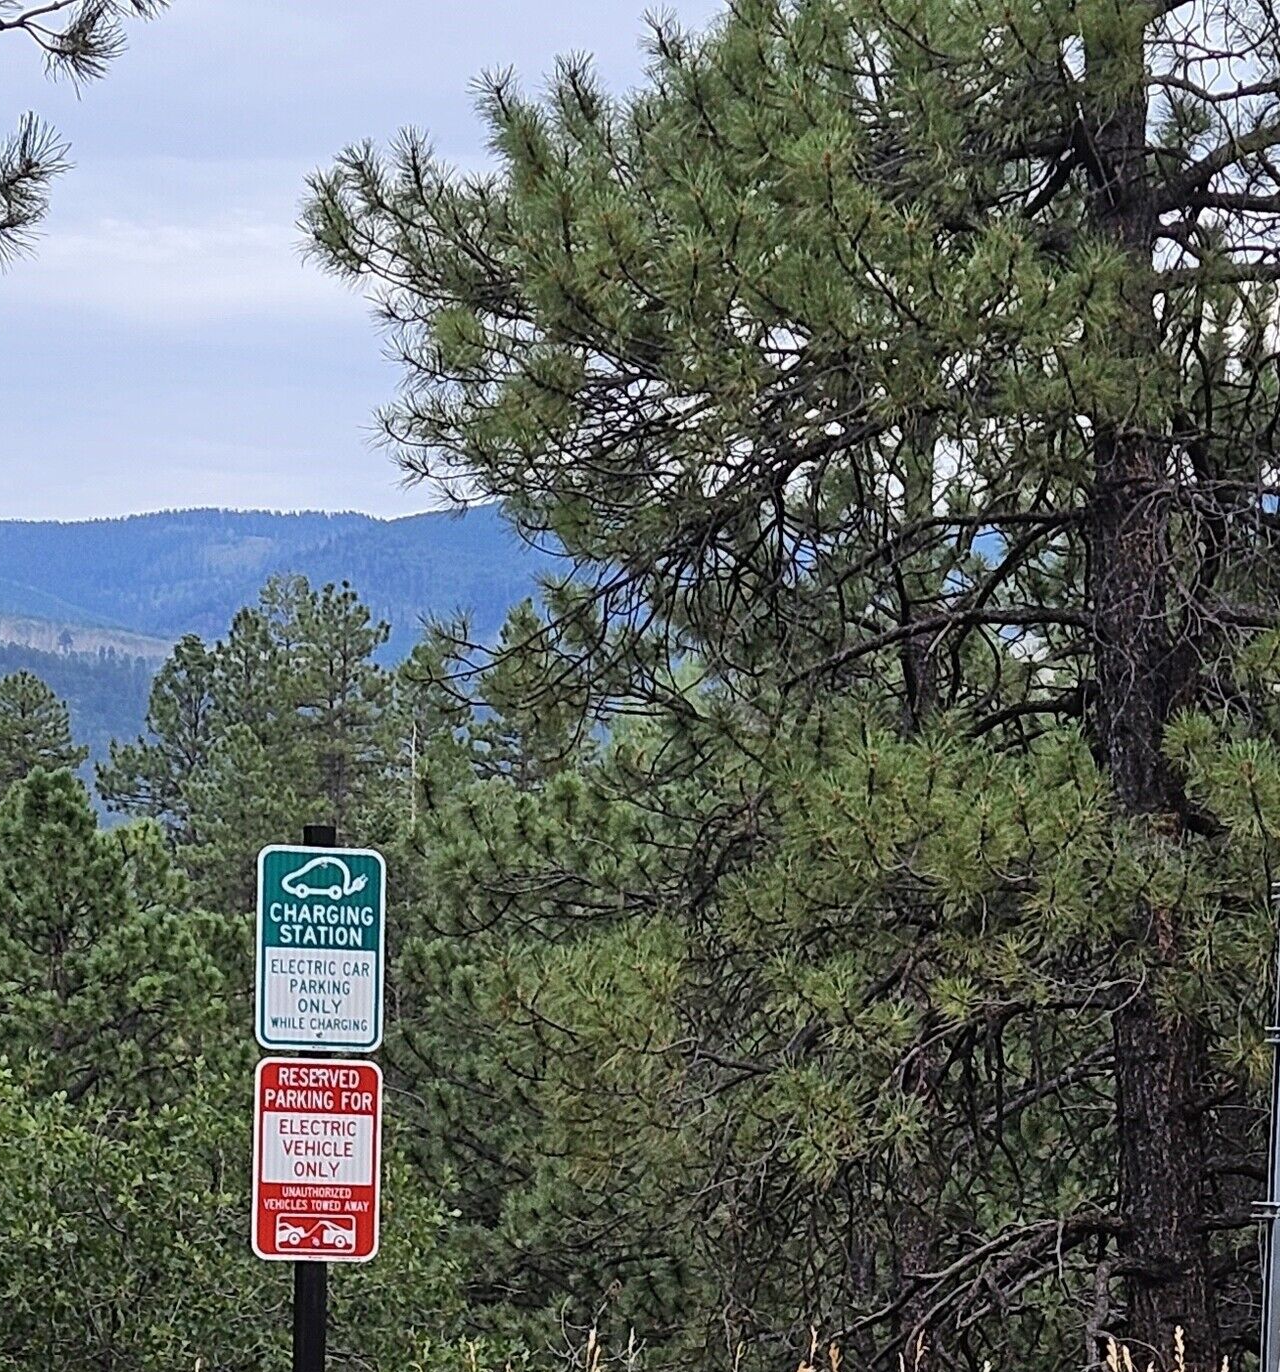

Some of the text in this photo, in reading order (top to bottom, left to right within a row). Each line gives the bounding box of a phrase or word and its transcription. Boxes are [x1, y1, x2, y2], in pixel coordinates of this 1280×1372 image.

[270, 902, 374, 926] CHARGING
[279, 924, 363, 947] STATION
[271, 958, 370, 977] ELECTRIC CAR
[289, 979, 351, 995] PARKING
[297, 998, 342, 1014] ONLY
[270, 1016, 368, 1031] WHILE CHARGING
[278, 1067, 360, 1089] RESERVED
[264, 1089, 373, 1112] PARKING FOR
[279, 1118, 357, 1137] ELECTRIC
[282, 1140, 353, 1157] VEHICLE
[293, 1162, 340, 1178] ONLY
[282, 1186, 352, 1199] UNAUTHORIZED
[263, 1198, 369, 1213] VEHICLES TOWED AWAY
